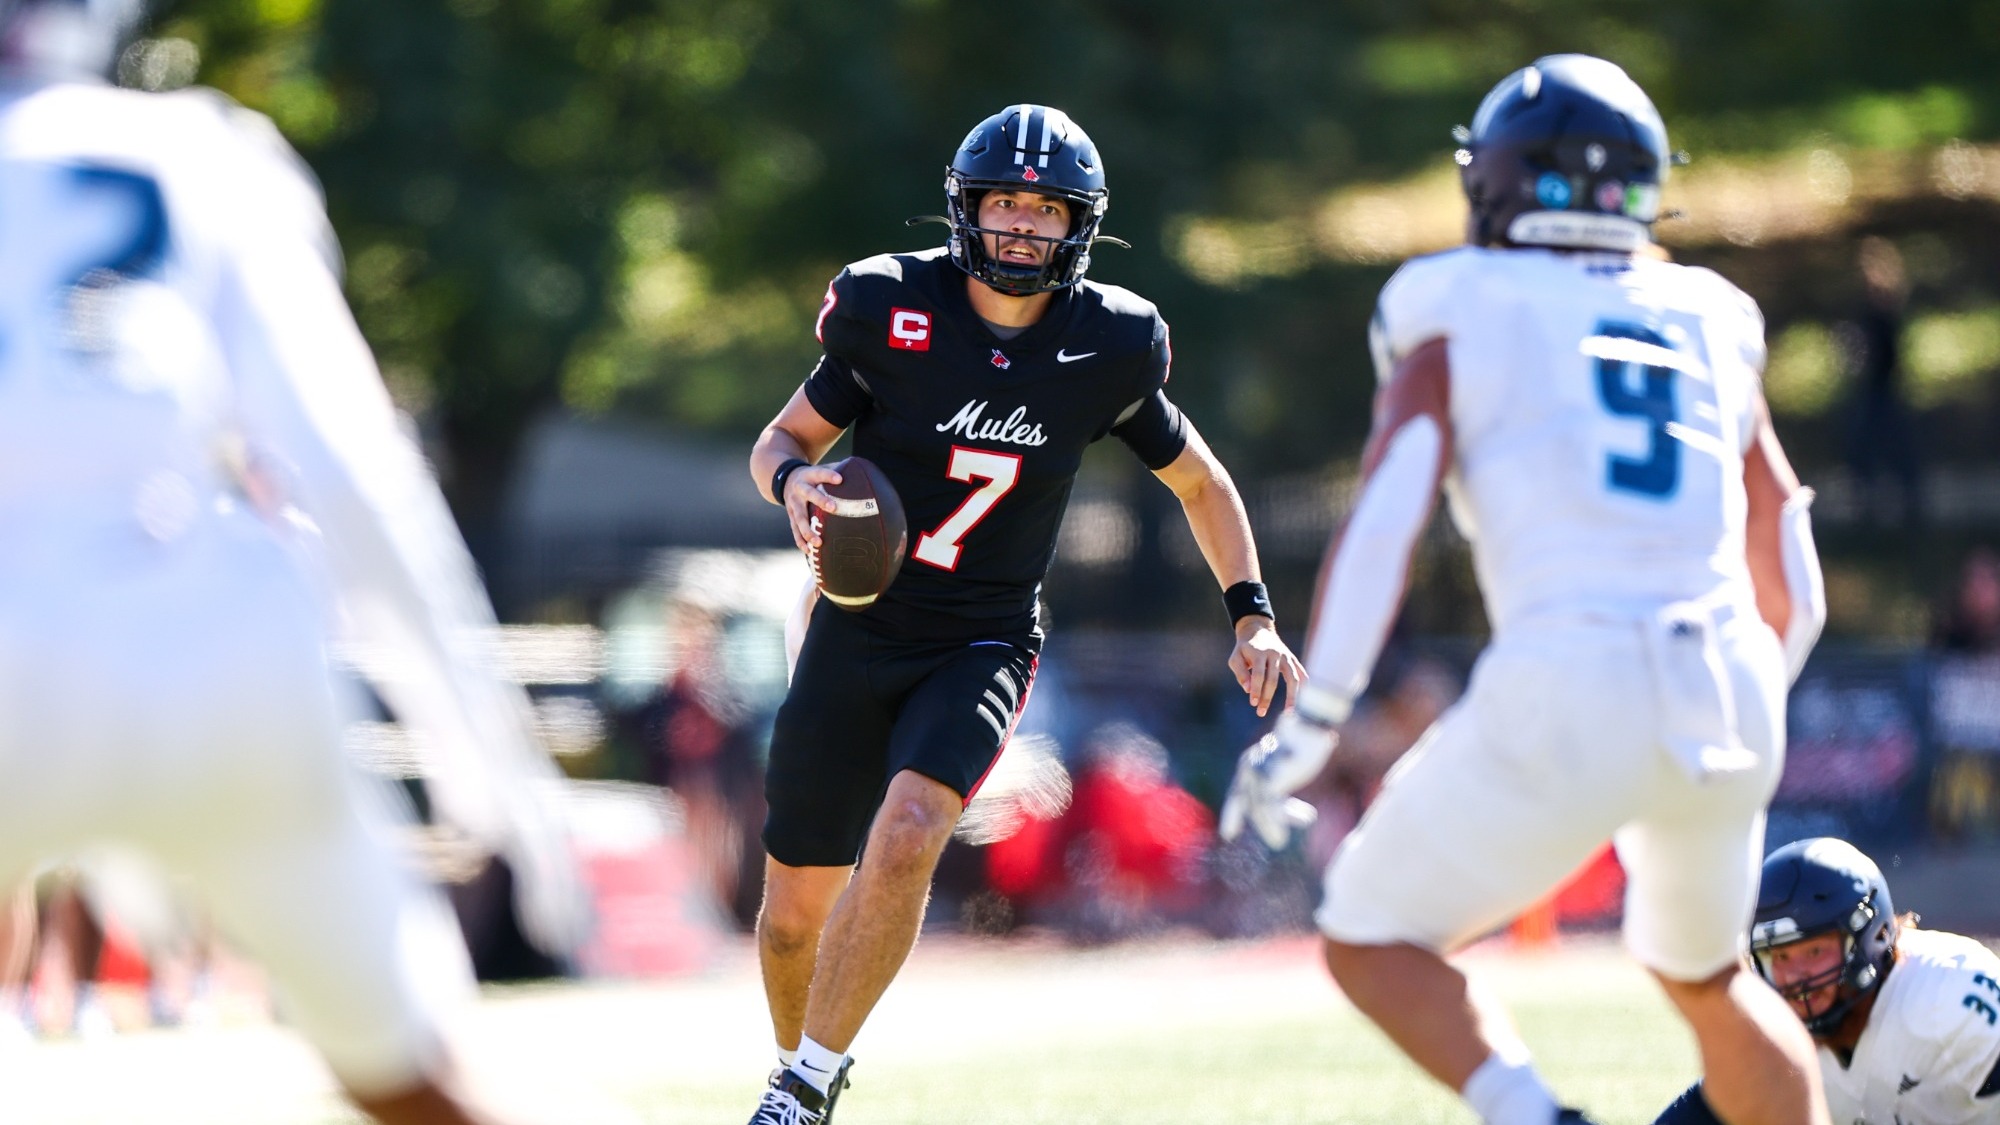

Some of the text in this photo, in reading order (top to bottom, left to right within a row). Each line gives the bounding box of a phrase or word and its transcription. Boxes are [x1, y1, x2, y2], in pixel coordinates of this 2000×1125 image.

[893, 311, 928, 340] C
[936, 399, 1047, 446] Mules
[1594, 320, 1680, 498] 9
[912, 445, 1022, 572] 7
